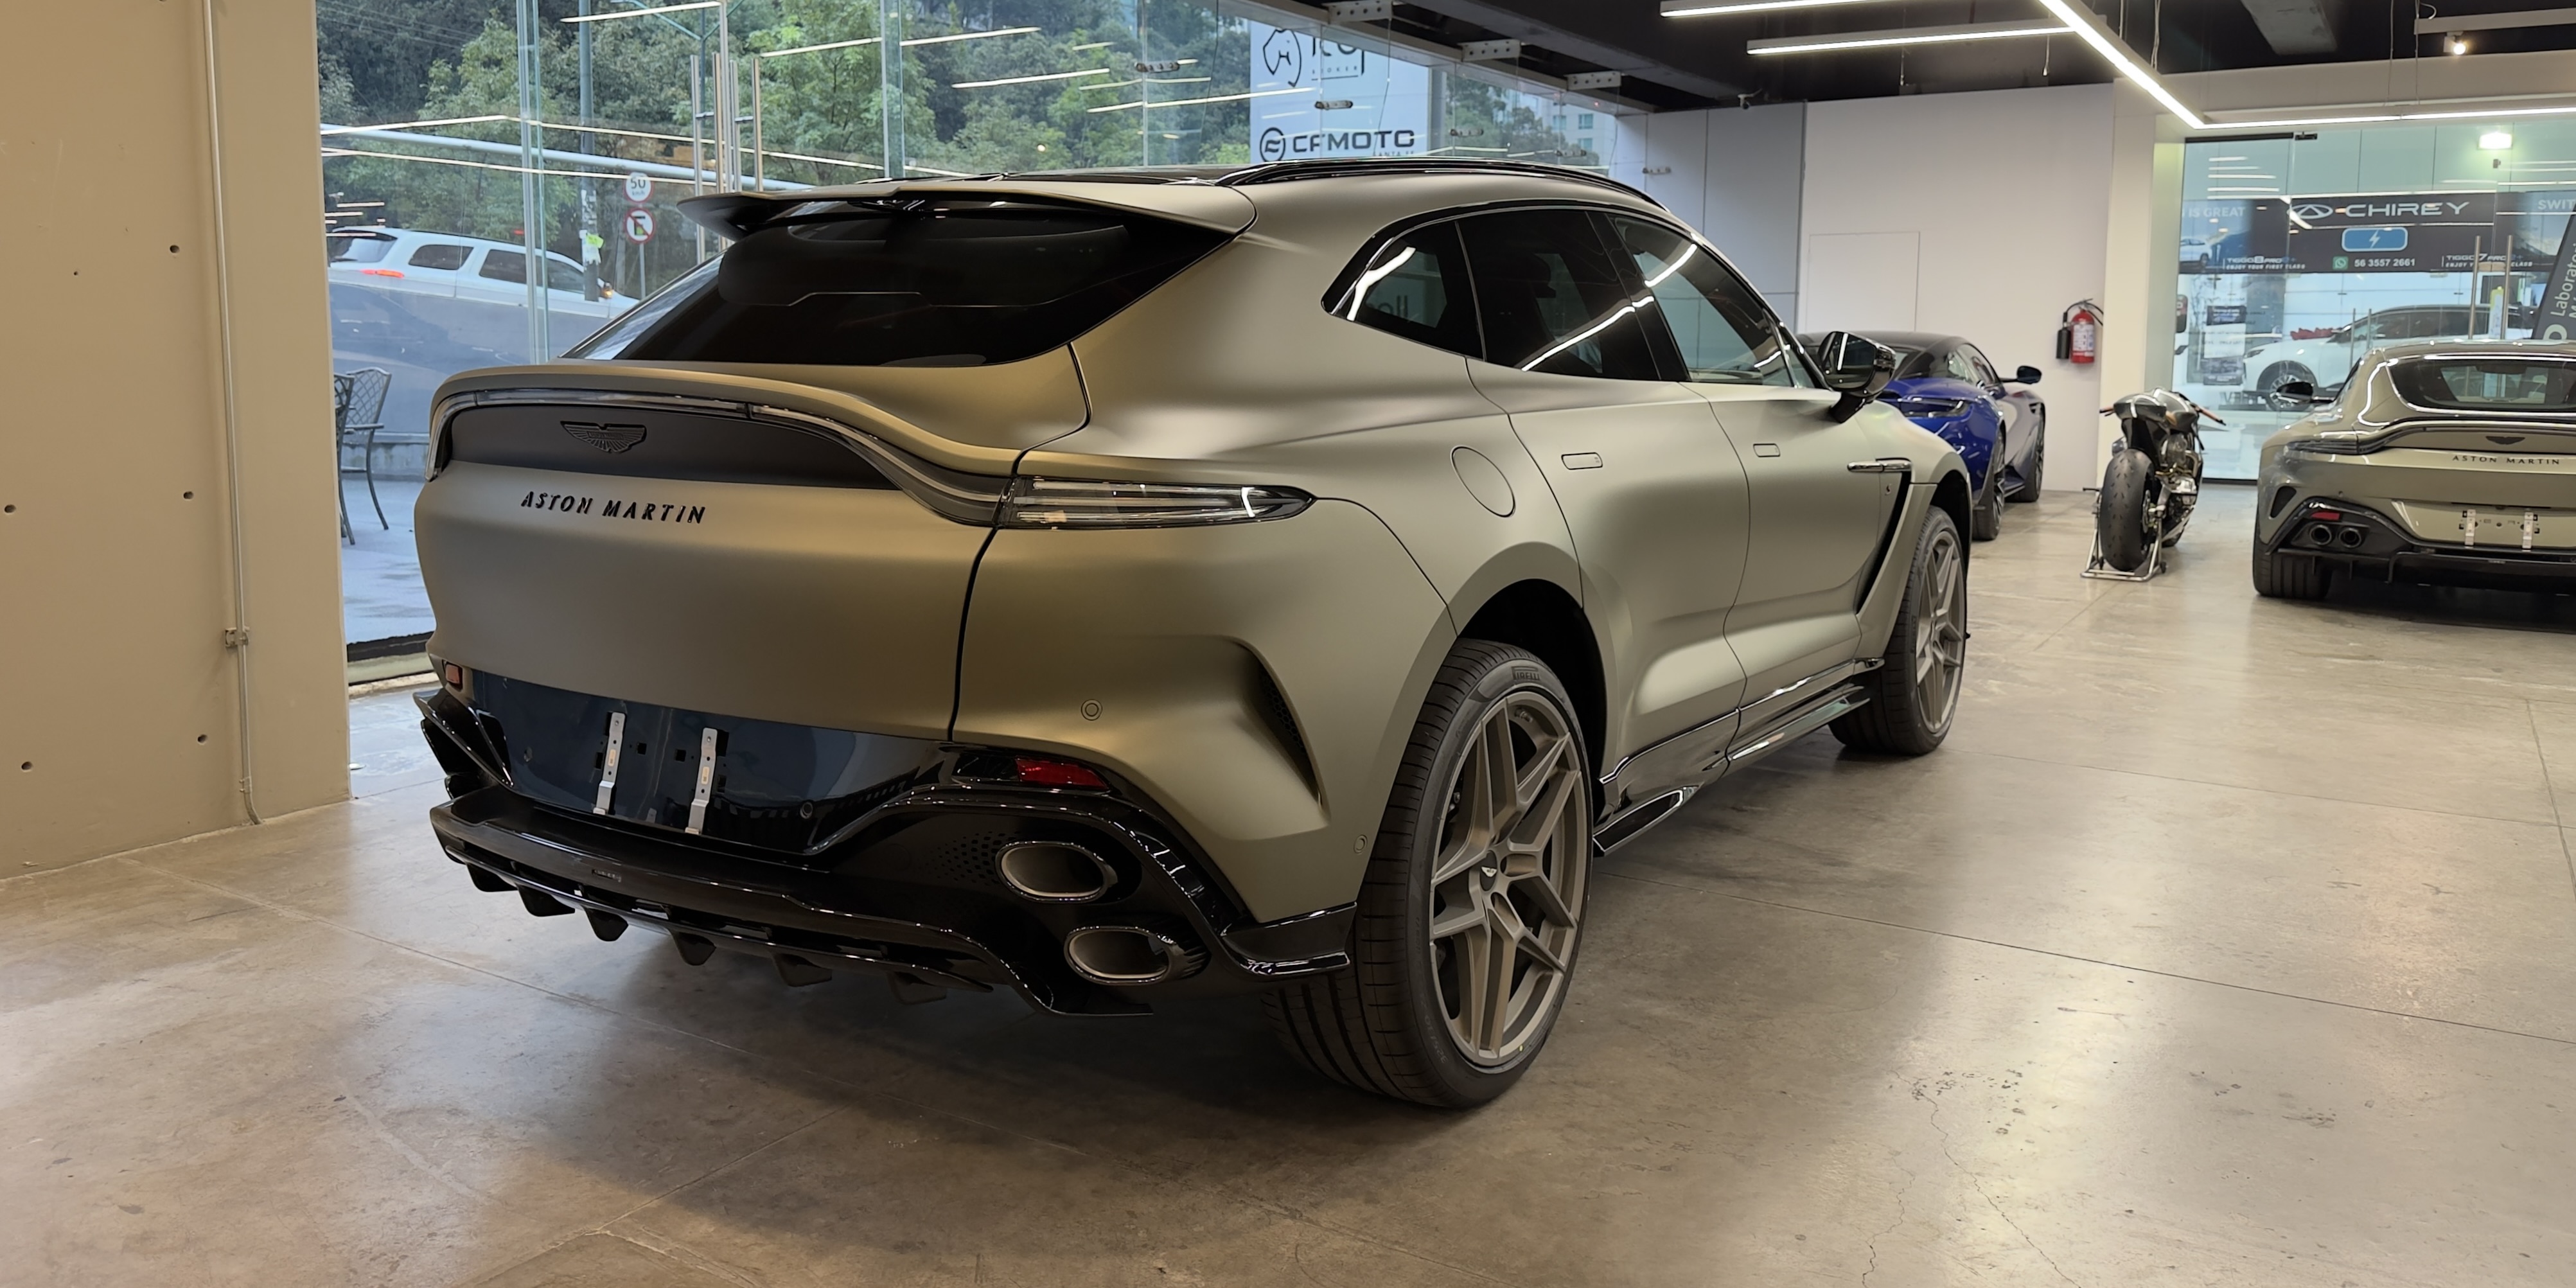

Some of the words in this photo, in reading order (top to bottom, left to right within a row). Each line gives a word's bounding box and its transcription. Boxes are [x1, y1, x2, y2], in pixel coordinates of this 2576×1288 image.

[1292, 130, 1415, 153] CFMOTO
[630, 175, 646, 189] 50
[2188, 208, 2200, 218] IS
[2203, 206, 2246, 217] GREAT
[2345, 202, 2470, 217] CHIREY
[2354, 259, 2367, 267] 56
[2368, 258, 2390, 267] 3557
[2393, 258, 2415, 267] 2661
[2550, 242, 2576, 317] Laborator
[2452, 455, 2498, 463] ASTON
[521, 490, 593, 514] ASTON
[601, 499, 706, 524] MARTIN
[1511, 666, 1541, 681] PIRELLI
